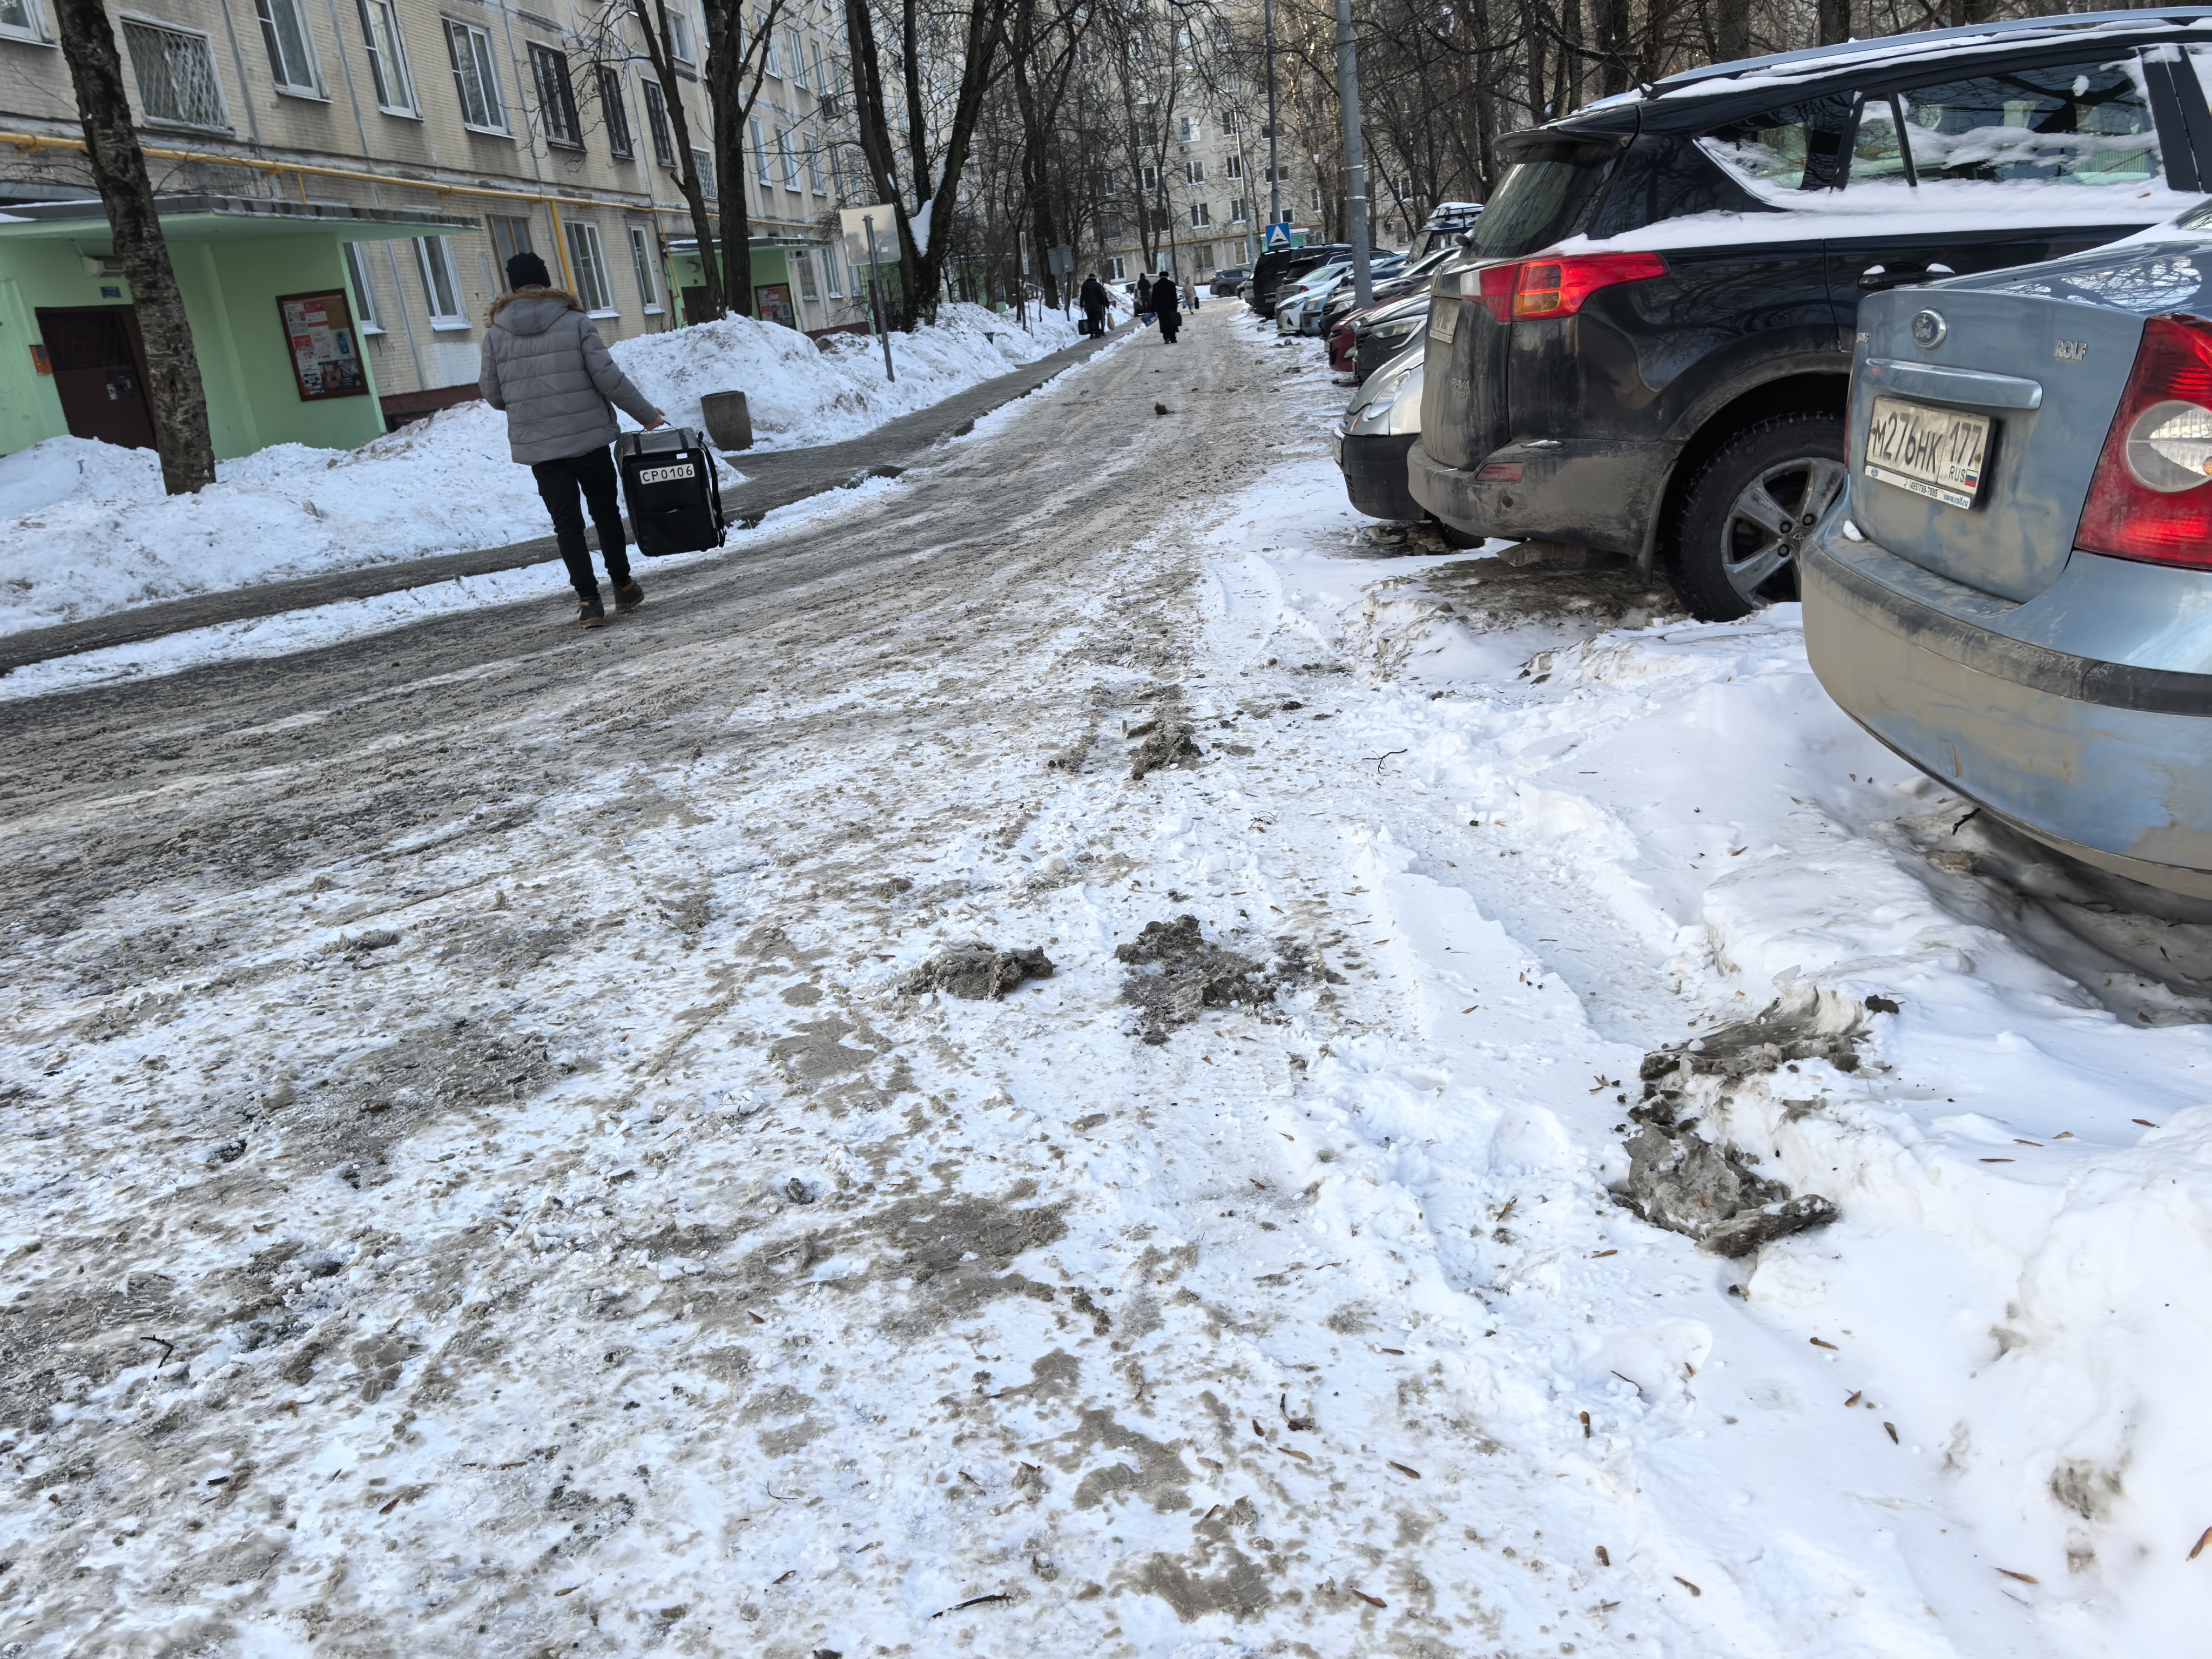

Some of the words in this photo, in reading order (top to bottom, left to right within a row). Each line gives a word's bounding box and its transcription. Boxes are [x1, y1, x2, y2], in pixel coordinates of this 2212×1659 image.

[2054, 340, 2087, 360] ROLF
[1950, 421, 1983, 467] 177
[1948, 466, 1966, 483] RUS
